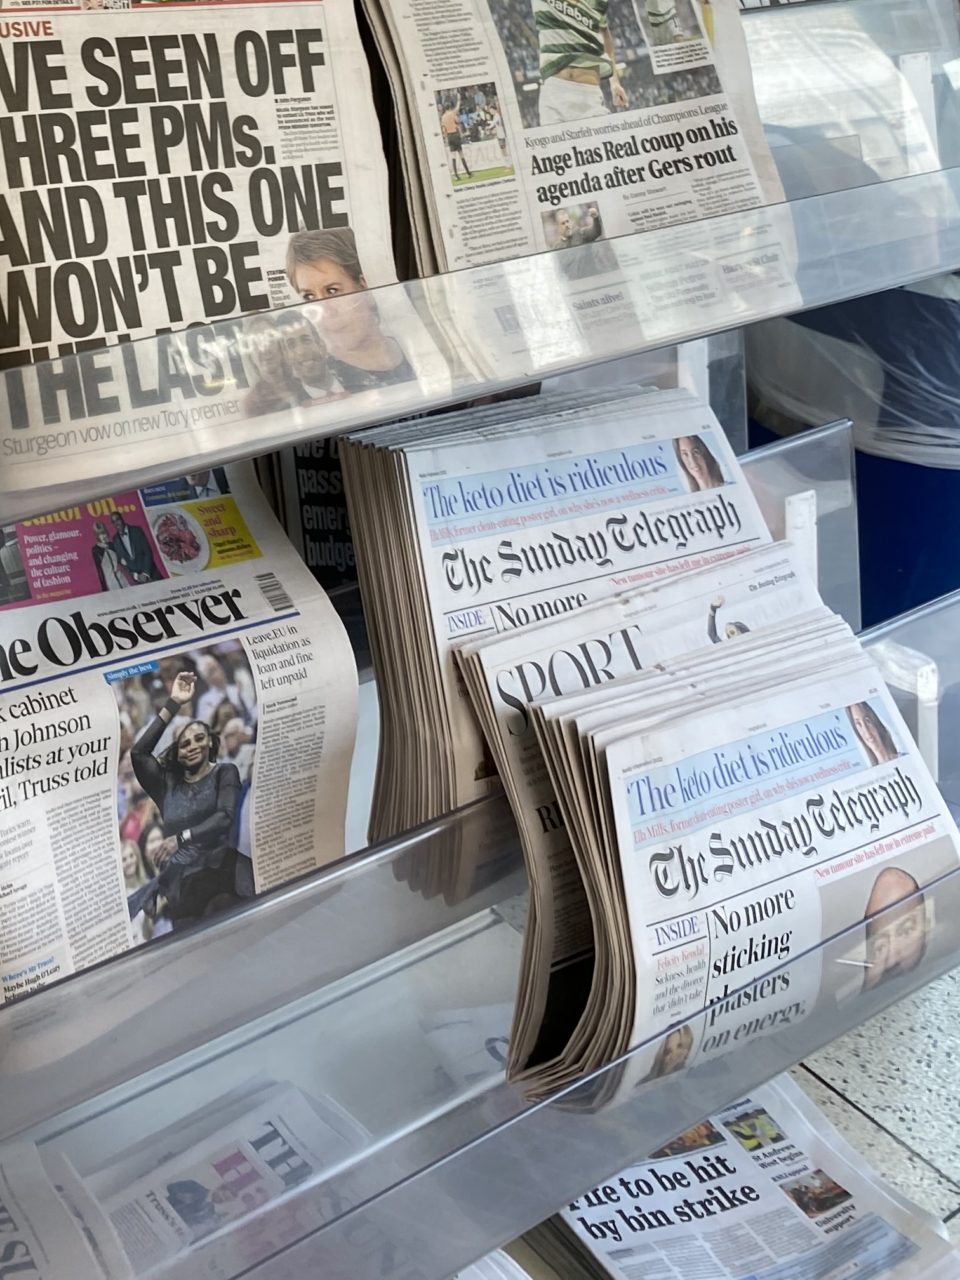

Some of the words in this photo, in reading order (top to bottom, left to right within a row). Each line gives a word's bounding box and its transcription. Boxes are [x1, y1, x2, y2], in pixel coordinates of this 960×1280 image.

[80, 31, 223, 108] SEEN
[233, 28, 327, 100] OFF
[530, 152, 573, 178] Ange
[573, 145, 603, 167] has
[602, 136, 640, 160] Real
[639, 131, 685, 156] coup
[685, 125, 712, 144] on
[711, 116, 739, 138] his
[536, 176, 604, 207] agenda
[604, 166, 645, 190] after
[646, 157, 694, 179] Gers
[693, 144, 738, 170] rout
[197, 502, 227, 514] Sweet
[441, 546, 494, 596] The
[497, 528, 615, 585] Sunday
[606, 494, 742, 553] Telegraph
[37, 586, 250, 667] Observer
[252, 638, 299, 660] liquidation
[300, 636, 312, 648] as
[8, 685, 79, 720] cabinet
[495, 624, 645, 737] SPORT
[11, 711, 92, 751] Johnson
[654, 915, 700, 946] INSIDE
[711, 905, 741, 939] No
[740, 888, 796, 922] more
[712, 929, 793, 980] sticking
[577, 1216, 623, 1242] by
[616, 1205, 675, 1233] bin
[673, 1184, 761, 1222] strike
